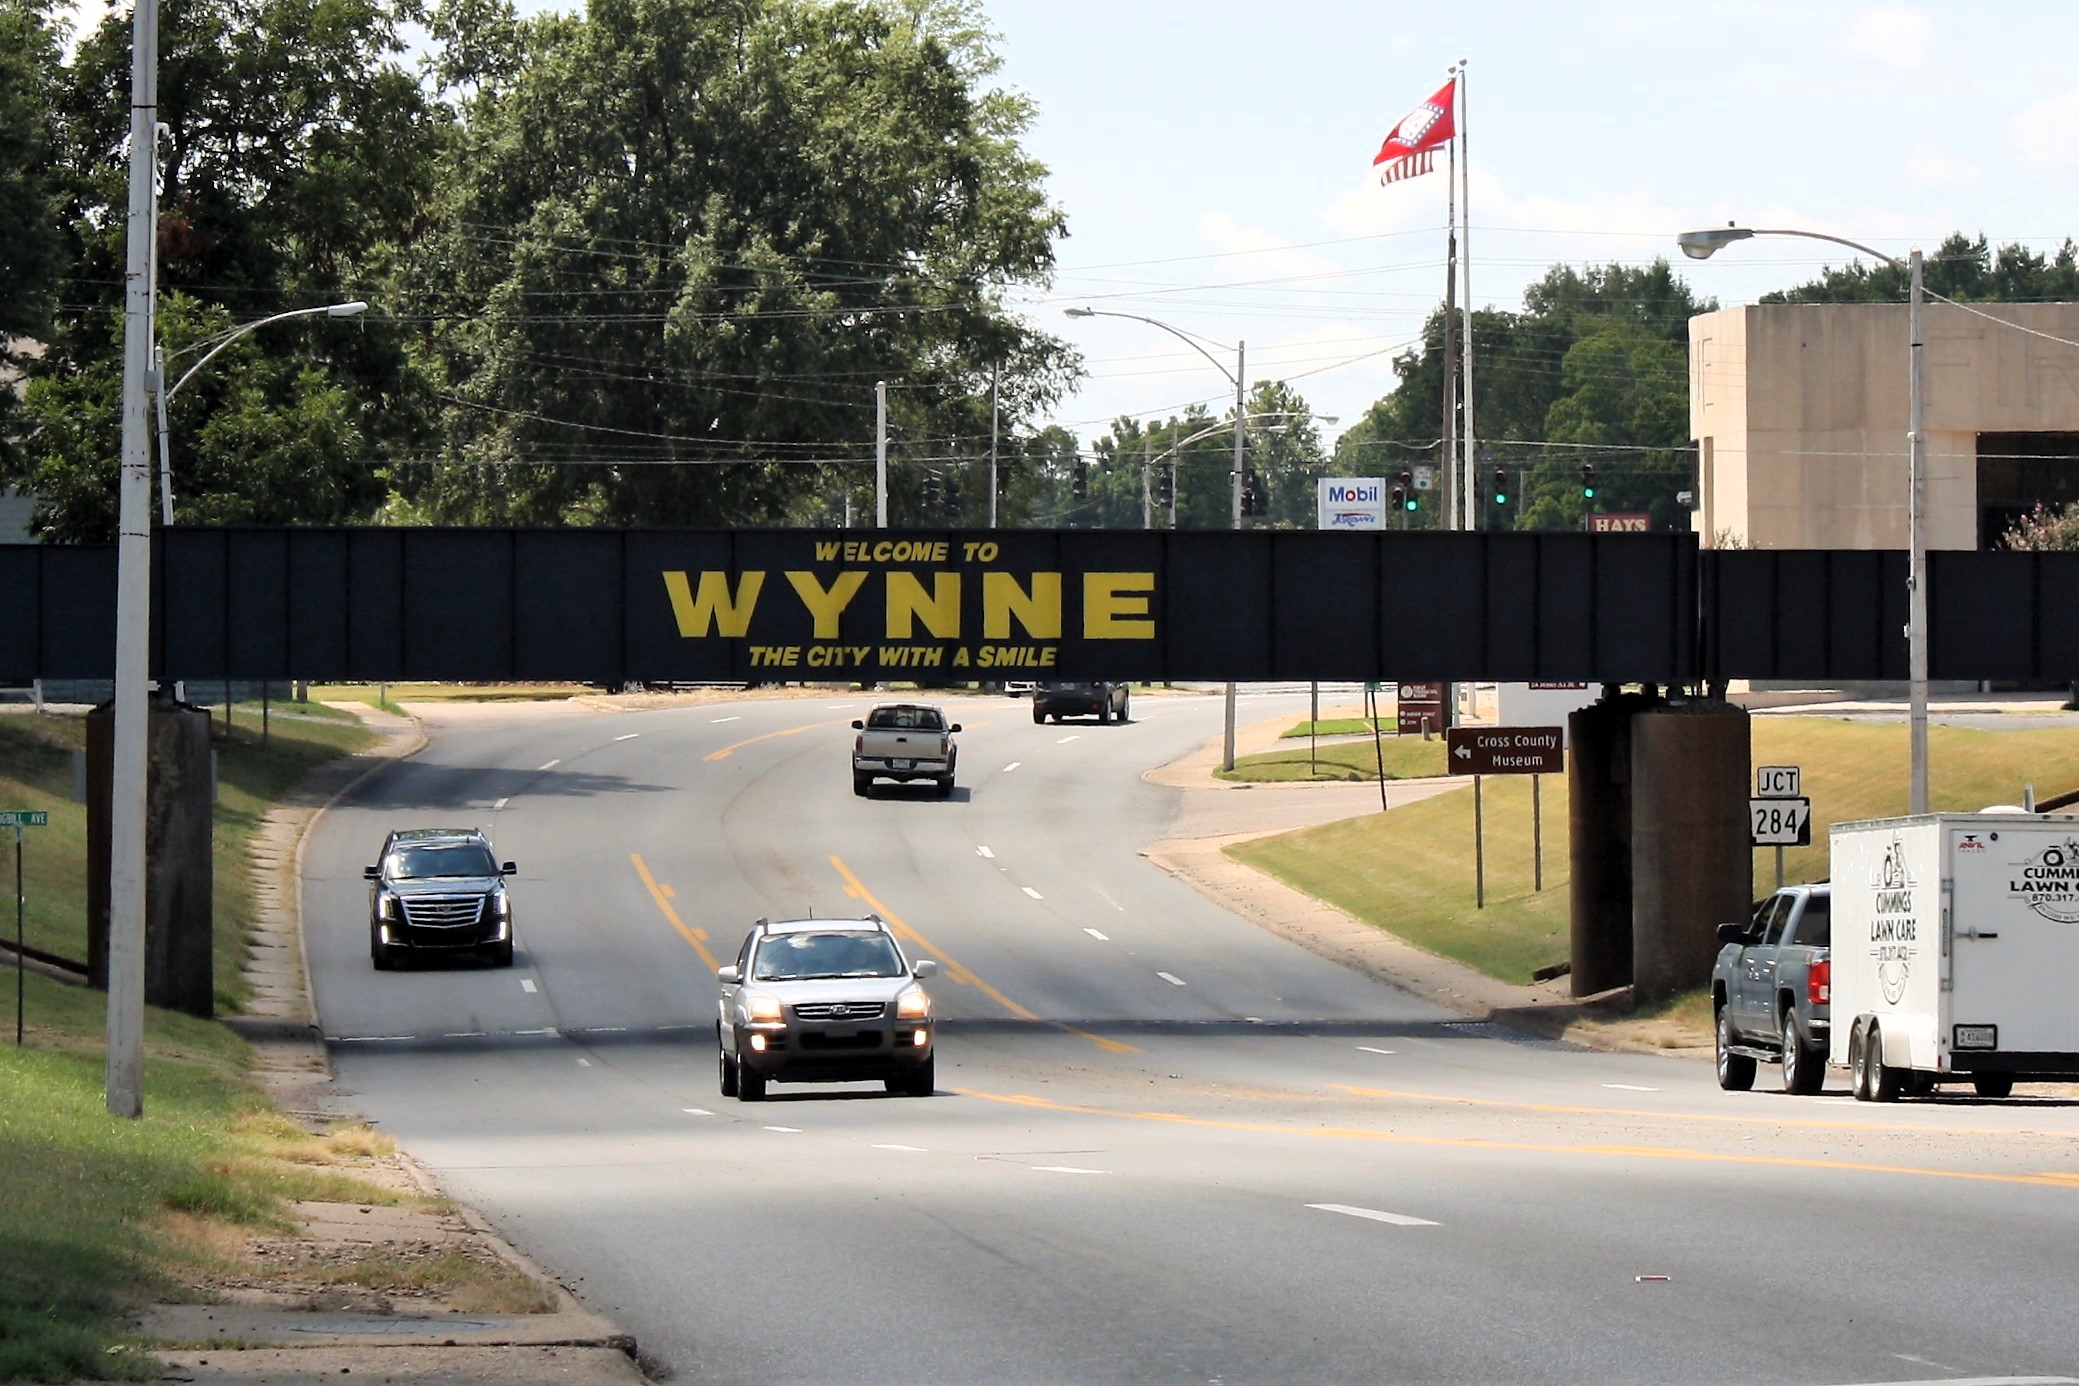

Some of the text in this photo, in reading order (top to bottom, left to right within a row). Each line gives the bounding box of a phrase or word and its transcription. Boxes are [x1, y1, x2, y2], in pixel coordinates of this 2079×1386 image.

[1329, 486, 1377, 502] Mobil
[1595, 519, 1646, 532] HAYS
[815, 541, 999, 562] WELCOME TO
[662, 570, 1156, 640] WYNNE
[749, 645, 1057, 667] THE CITY WITH A SMILE
[1477, 734, 1557, 749] Cross County
[1492, 755, 1543, 767] Museum
[1761, 771, 1797, 792] JCT
[31, 813, 46, 824] AVE
[1756, 808, 1797, 835] 284
[2010, 880, 2069, 892] LAWN
[1871, 918, 1916, 942] LAWN CARE
